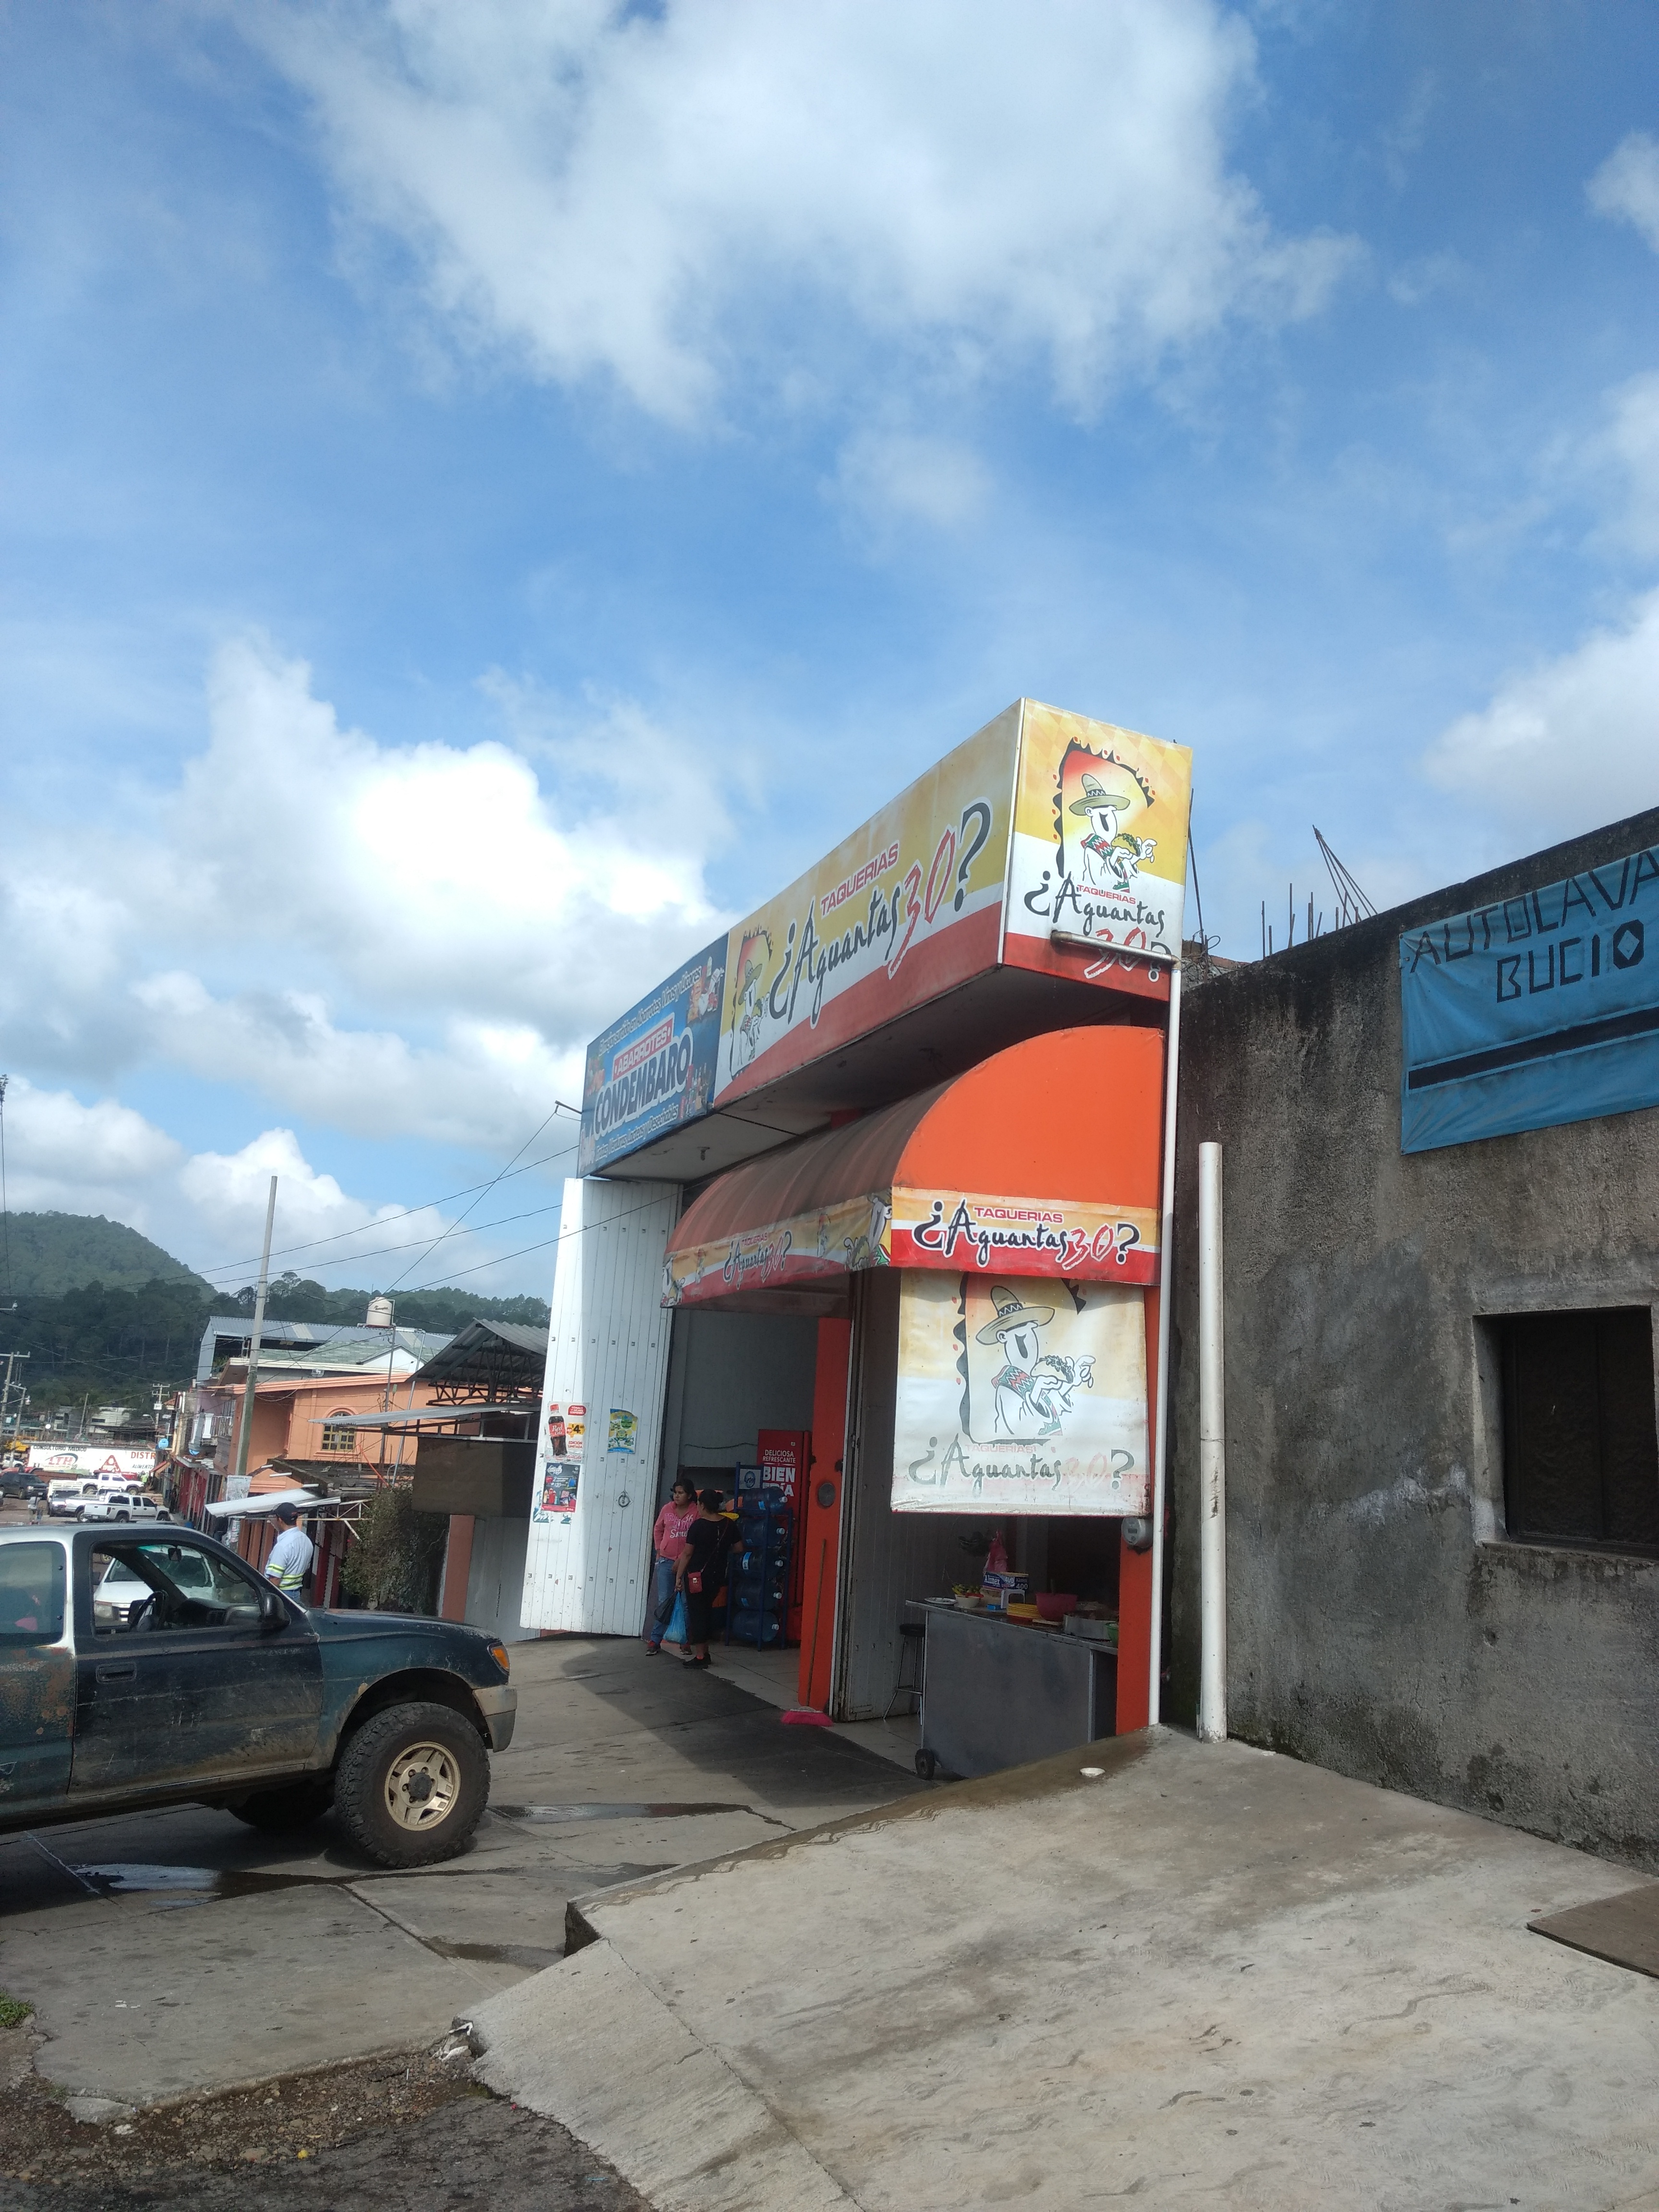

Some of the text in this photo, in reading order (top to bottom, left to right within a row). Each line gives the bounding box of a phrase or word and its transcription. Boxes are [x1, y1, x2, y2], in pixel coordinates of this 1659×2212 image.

[821, 842, 899, 915] TAQUERIAS
[1077, 884, 1136, 905] TAQUERIAS
[1497, 919, 1644, 1003] BUCIO
[617, 1026, 667, 1075] ABARROTES
[595, 1034, 691, 1135] CONDEMBARO
[974, 1207, 1063, 1223] TAQUERIAS
[742, 1233, 768, 1246] TAQUERIAS
[965, 1444, 1035, 1454] TAQUERIAS
[48, 1456, 74, 1466] LTH
[762, 1466, 796, 1483] BIEN
